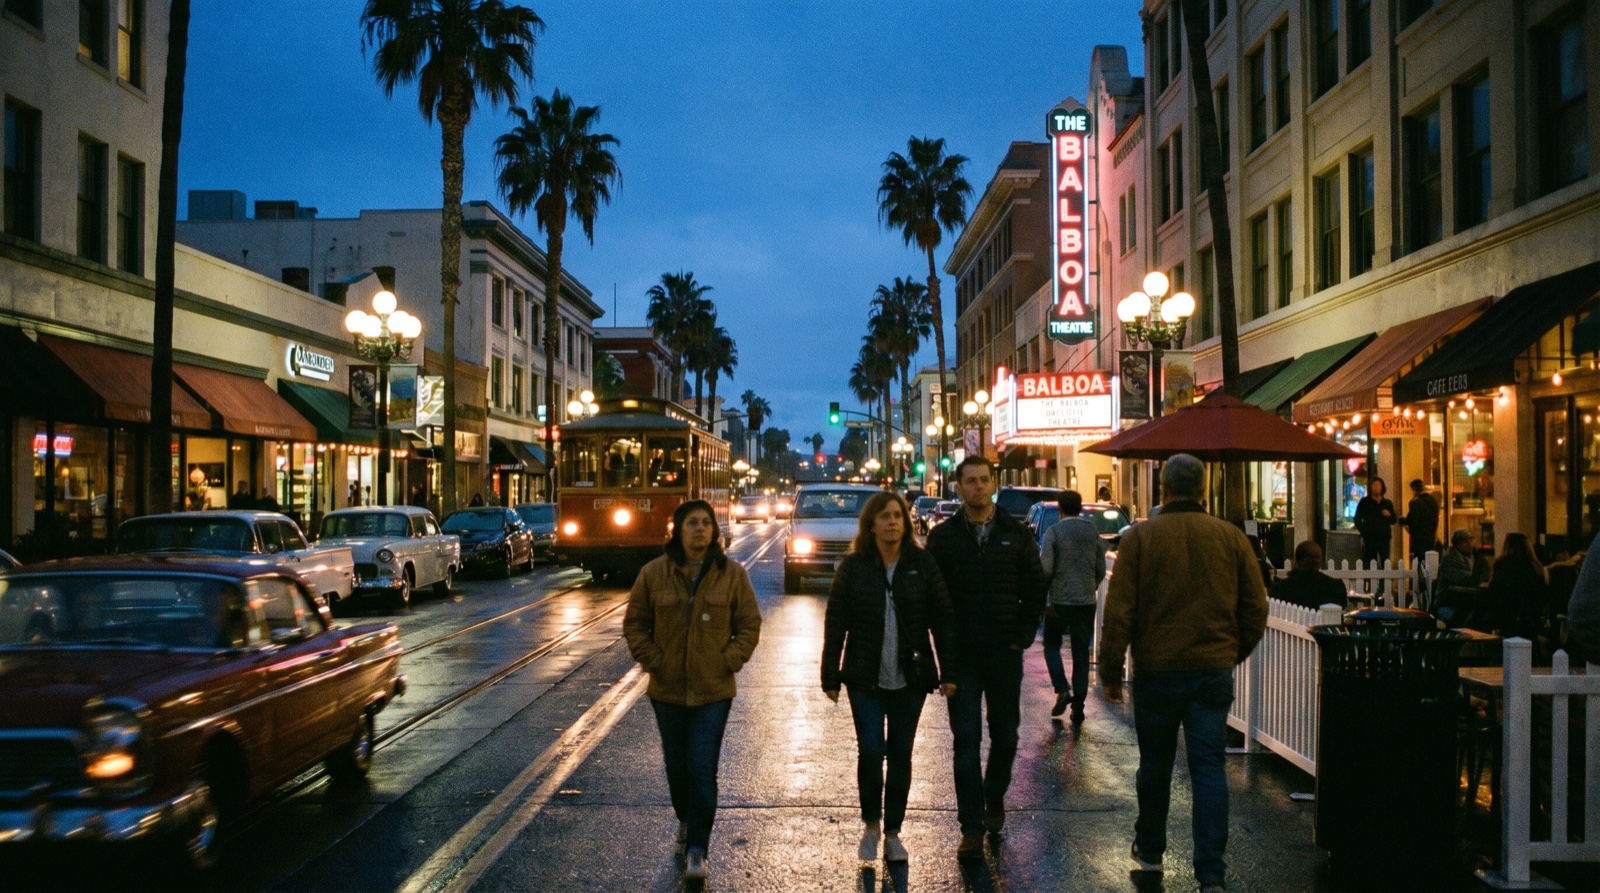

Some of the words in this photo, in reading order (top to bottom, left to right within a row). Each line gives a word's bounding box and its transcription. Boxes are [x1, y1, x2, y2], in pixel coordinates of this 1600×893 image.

[1054, 115, 1086, 131] THE
[1058, 136, 1084, 315] BALBOA
[1050, 321, 1093, 333] THEATRE
[1023, 374, 1105, 396] BALBOA
[1427, 378, 1446, 396] CAFE
[1060, 399, 1089, 407] BALBOA
[1048, 417, 1081, 426] THEATRE
